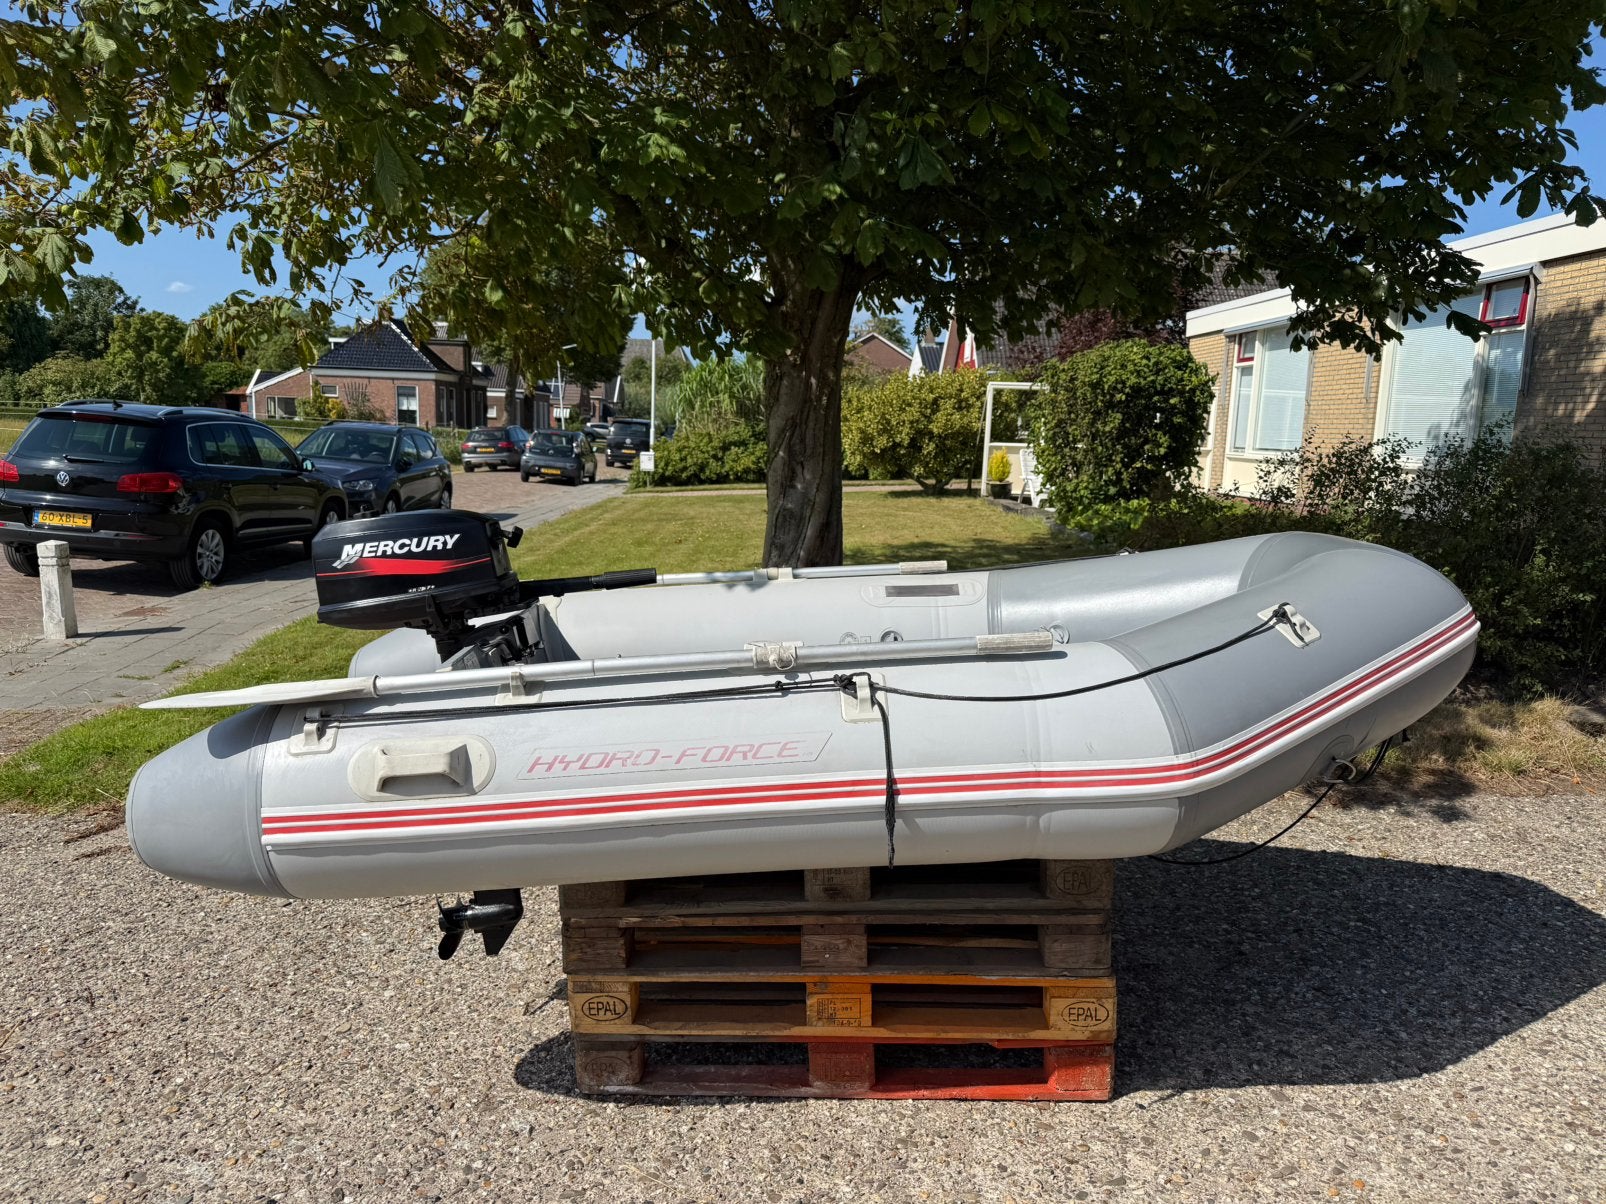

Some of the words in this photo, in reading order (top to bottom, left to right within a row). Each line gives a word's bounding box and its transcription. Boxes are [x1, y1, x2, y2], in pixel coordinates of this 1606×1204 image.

[337, 533, 461, 564] MERCURY
[526, 740, 807, 774] HYDRO-FORCE
[588, 1000, 621, 1016] EPAL
[1068, 1007, 1102, 1022] EPAL
